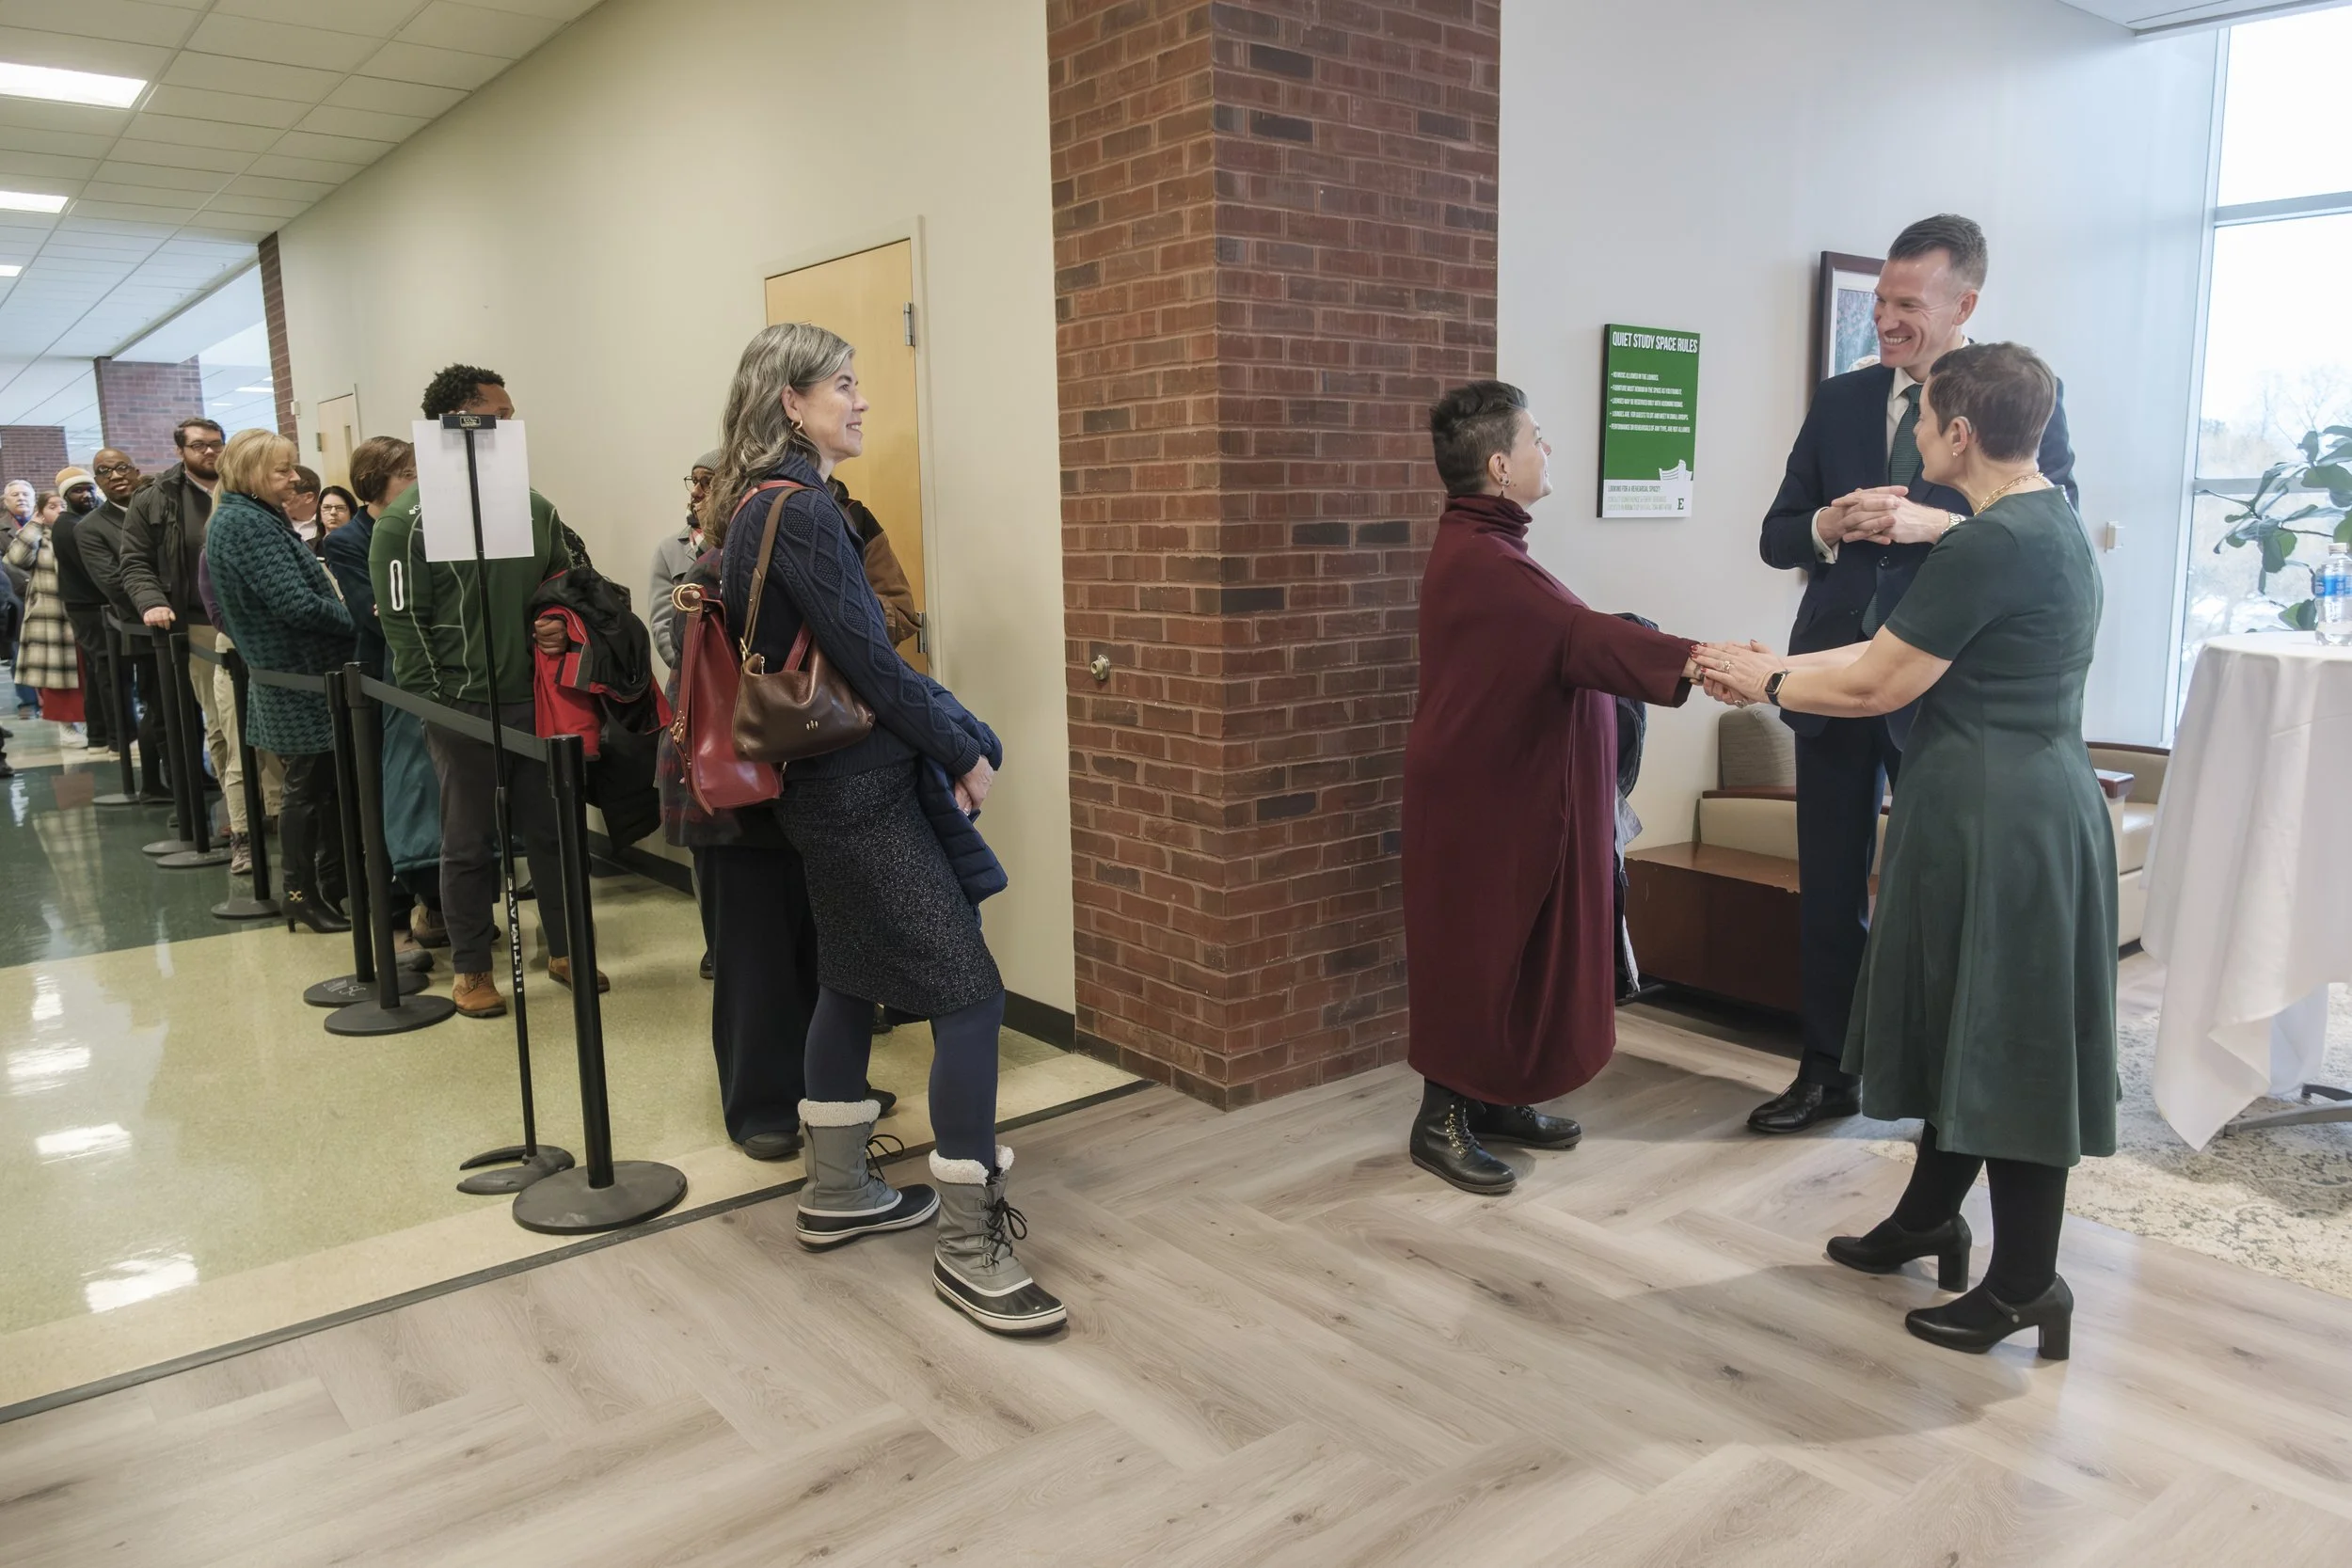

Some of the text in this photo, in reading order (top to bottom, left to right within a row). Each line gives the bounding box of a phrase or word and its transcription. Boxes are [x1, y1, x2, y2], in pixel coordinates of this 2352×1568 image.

[1613, 331, 1698, 354] QUIET STUDY SPACE RULES
[1677, 498, 1685, 511] E
